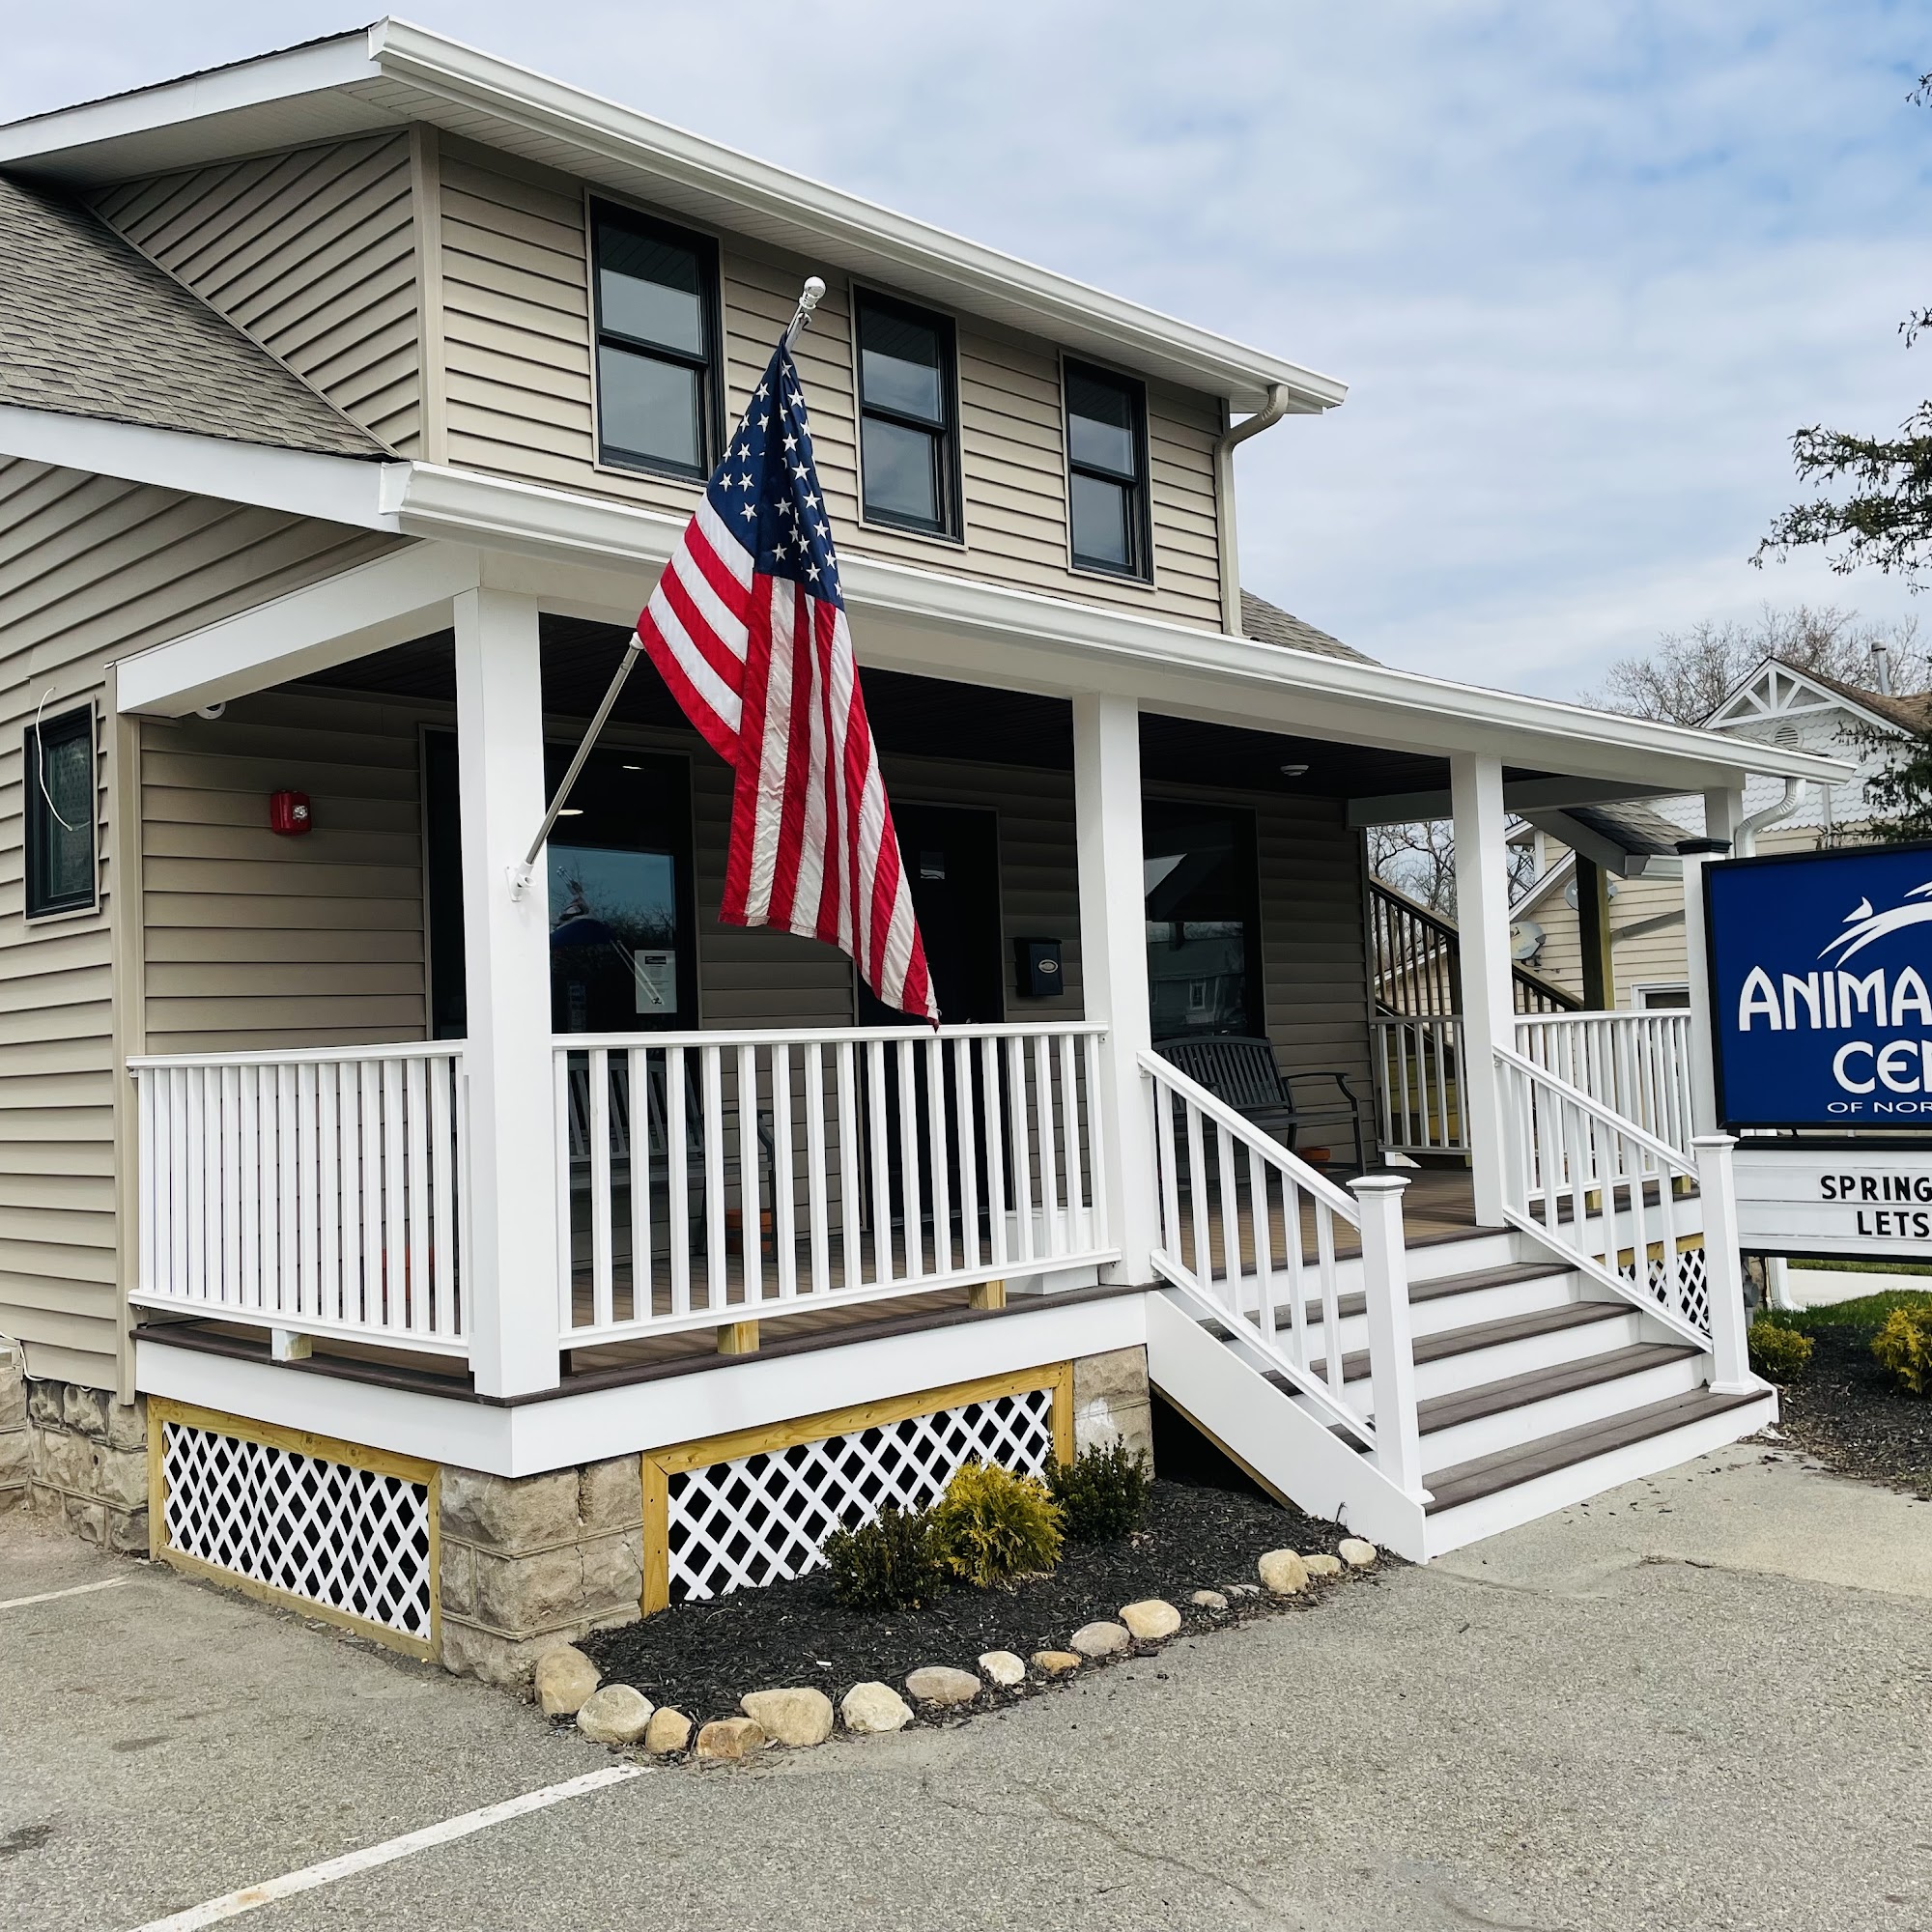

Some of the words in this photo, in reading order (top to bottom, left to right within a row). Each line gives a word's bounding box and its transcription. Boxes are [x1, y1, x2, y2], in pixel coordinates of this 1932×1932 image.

[1739, 966, 1932, 1032] ANIMA
[1827, 1101, 1863, 1114] OF
[1820, 1175, 1932, 1203] SPRING
[1857, 1210, 1930, 1238] LETS
